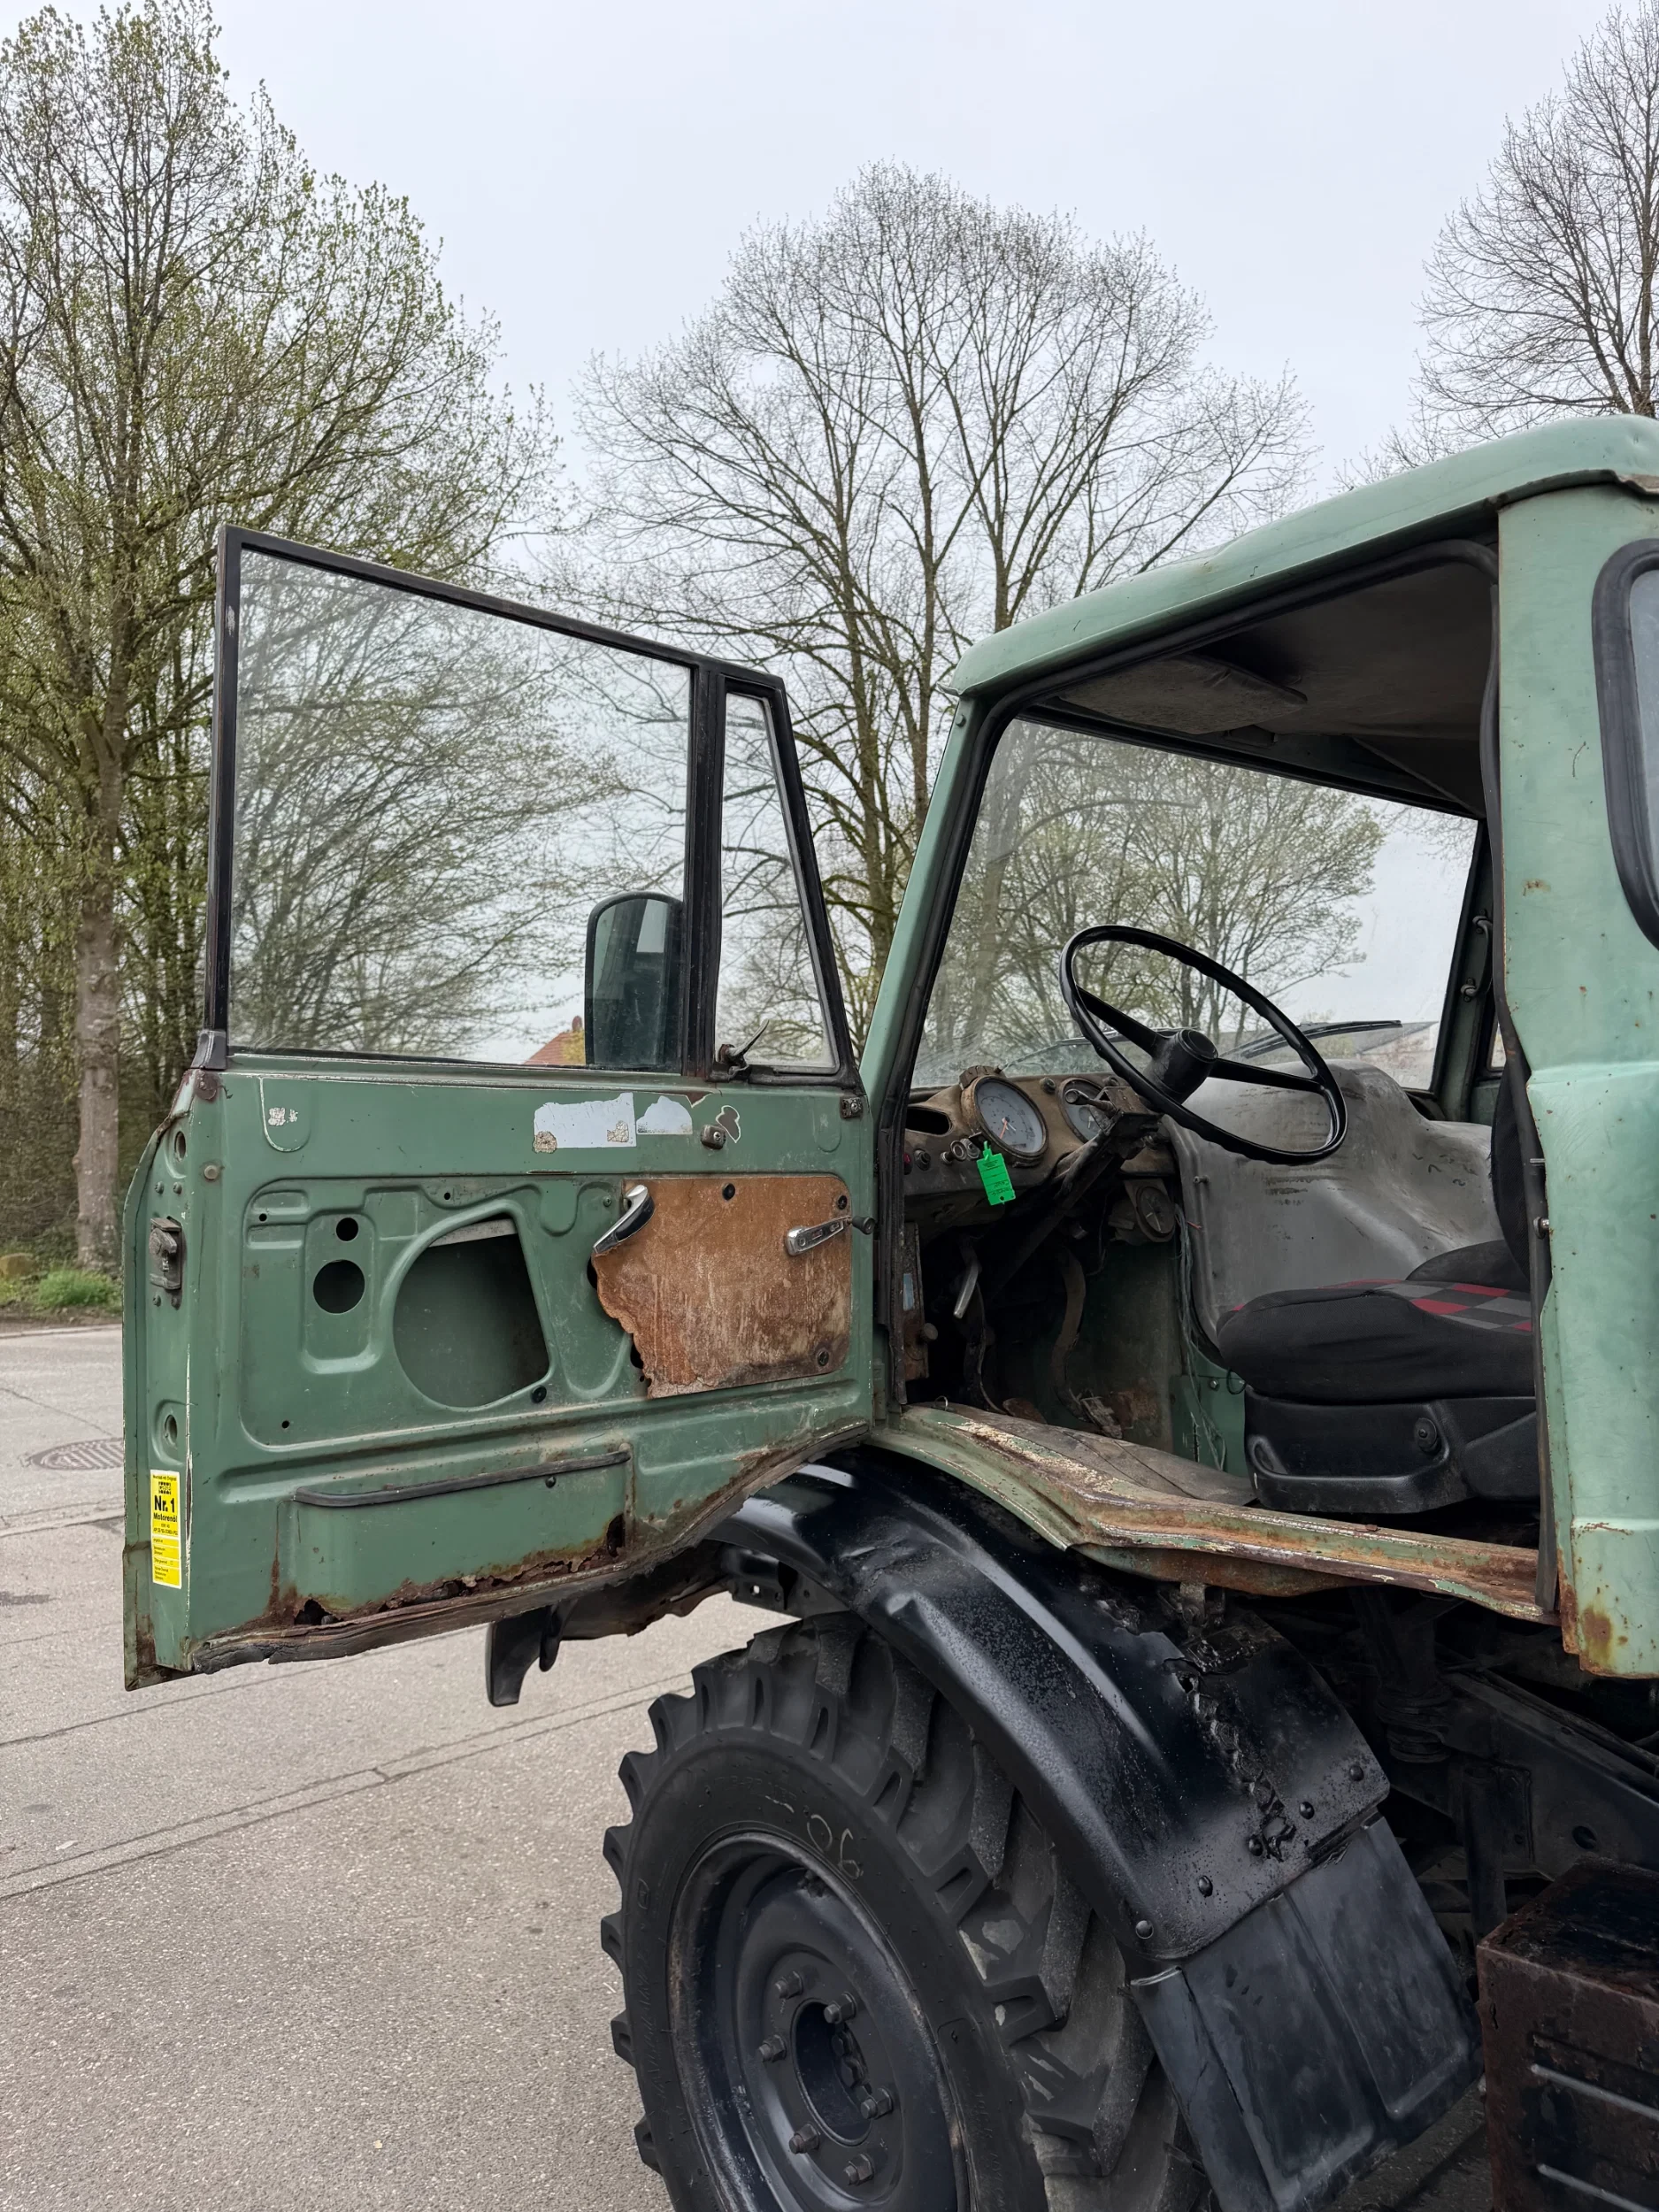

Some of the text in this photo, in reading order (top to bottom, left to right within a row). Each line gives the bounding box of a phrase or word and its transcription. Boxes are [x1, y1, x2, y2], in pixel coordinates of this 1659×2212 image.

[154, 1495, 175, 1513] Nr. 1
[153, 1512, 178, 1523] Motorenöl
